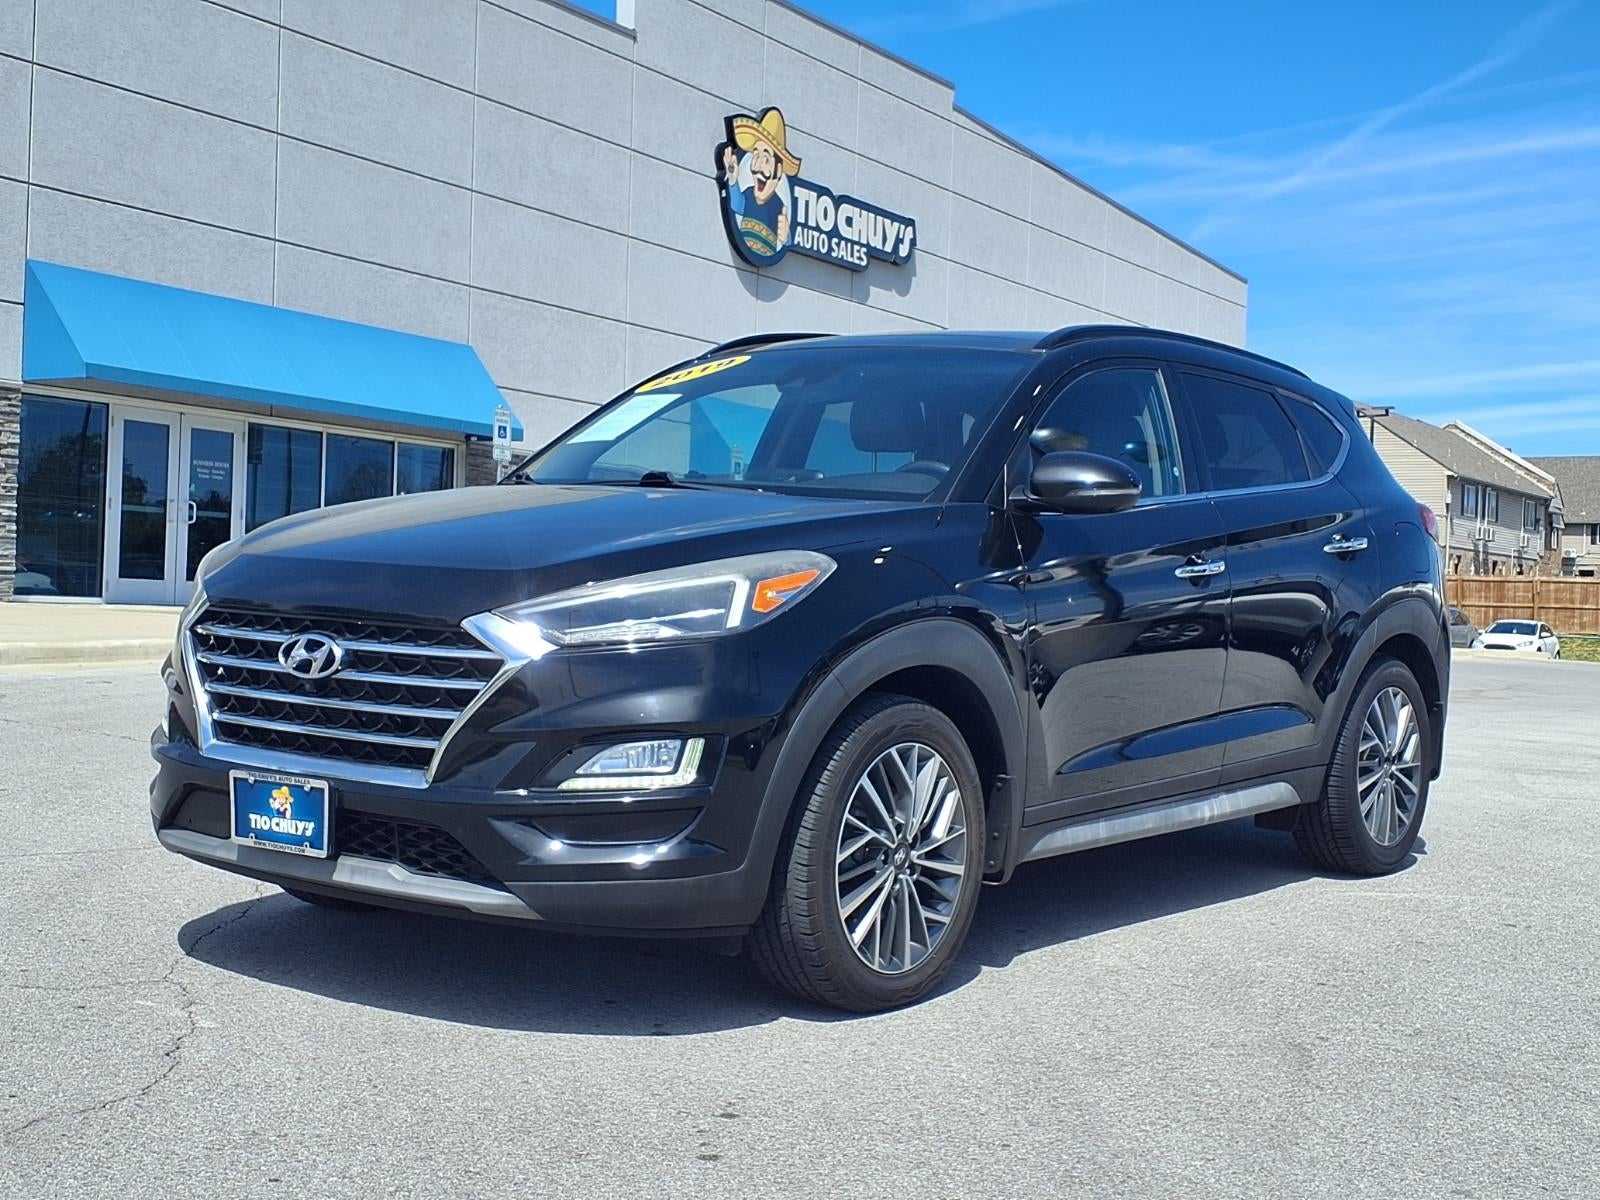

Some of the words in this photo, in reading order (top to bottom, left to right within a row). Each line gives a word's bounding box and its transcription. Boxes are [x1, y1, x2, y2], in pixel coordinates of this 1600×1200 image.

[794, 186, 835, 231] TIO
[837, 203, 914, 257] CHUY'S
[794, 226, 828, 254] AUTO
[831, 238, 868, 266] SALES
[650, 359, 737, 388] 2019
[294, 777, 311, 785] SALES
[249, 813, 271, 830] TIO
[271, 817, 315, 837] CHUY'S
[253, 841, 306, 854] WWW.TIOCHUYS.COM
